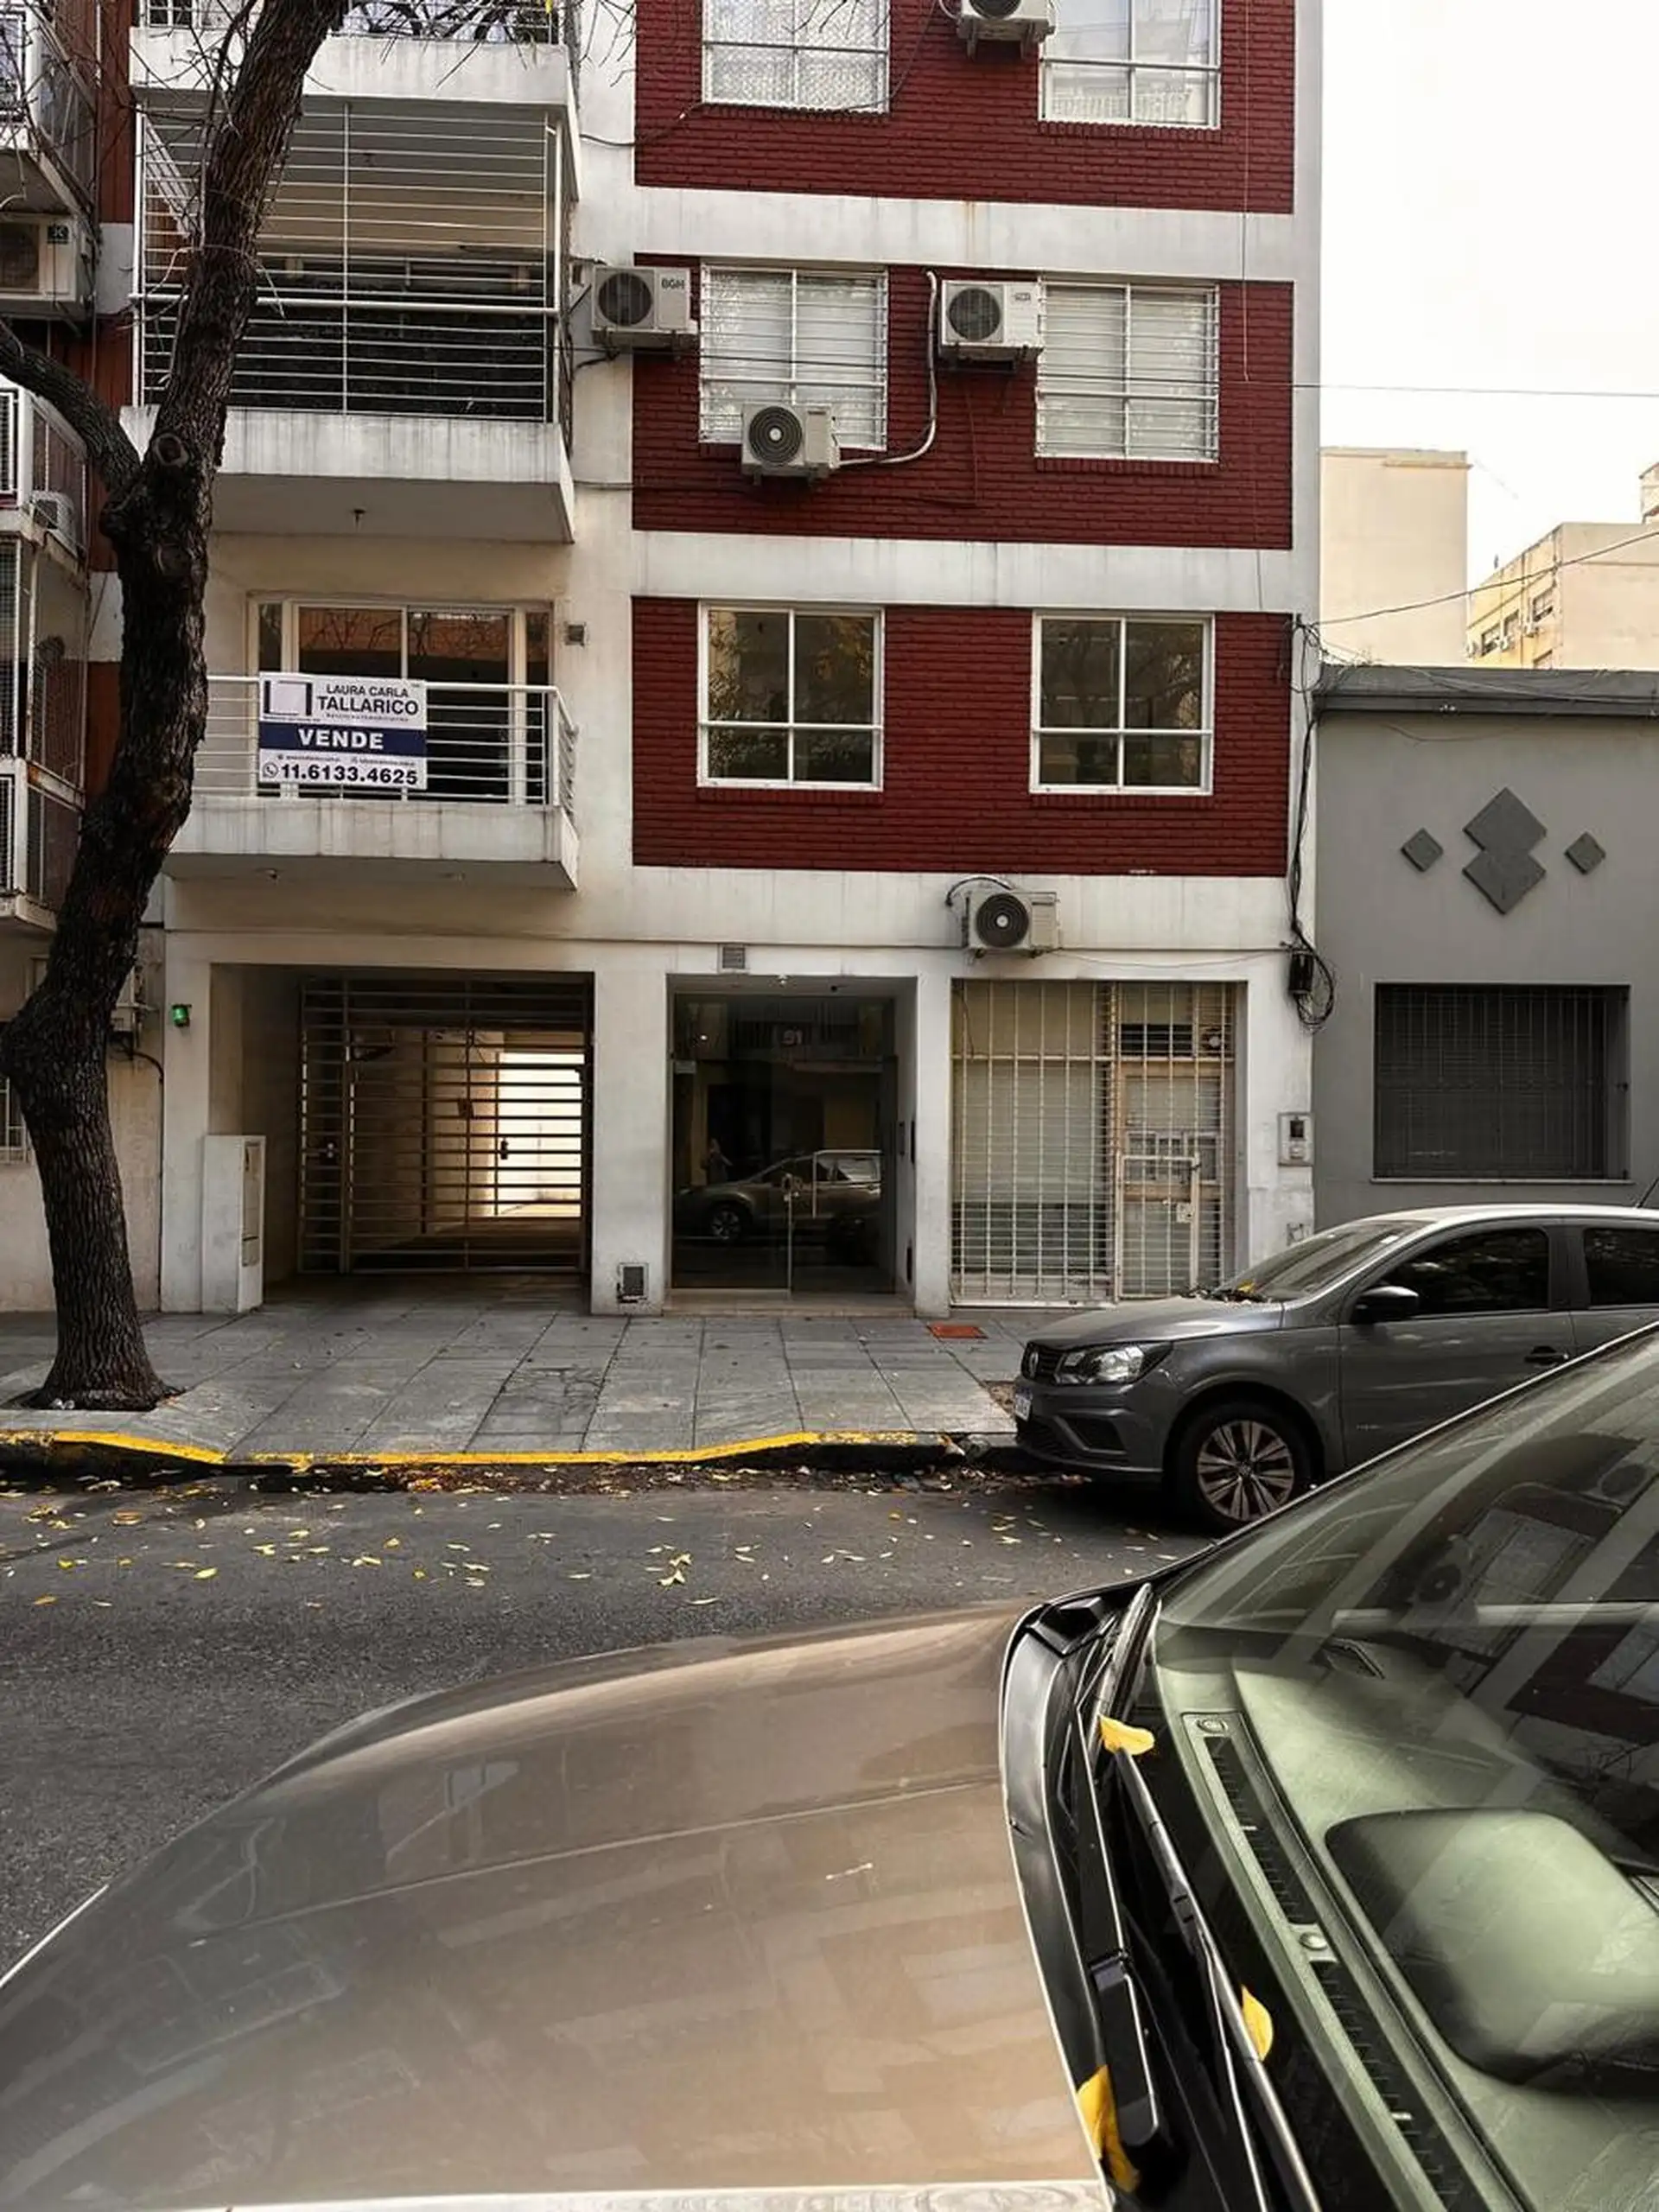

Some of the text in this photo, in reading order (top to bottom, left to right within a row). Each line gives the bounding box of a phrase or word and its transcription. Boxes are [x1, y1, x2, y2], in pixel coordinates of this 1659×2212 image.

[326, 683, 409, 697] LAURA CARLA
[316, 696, 419, 715] TALLARICO
[298, 728, 385, 750] VENDE
[281, 764, 418, 785] 11.6133.4625
